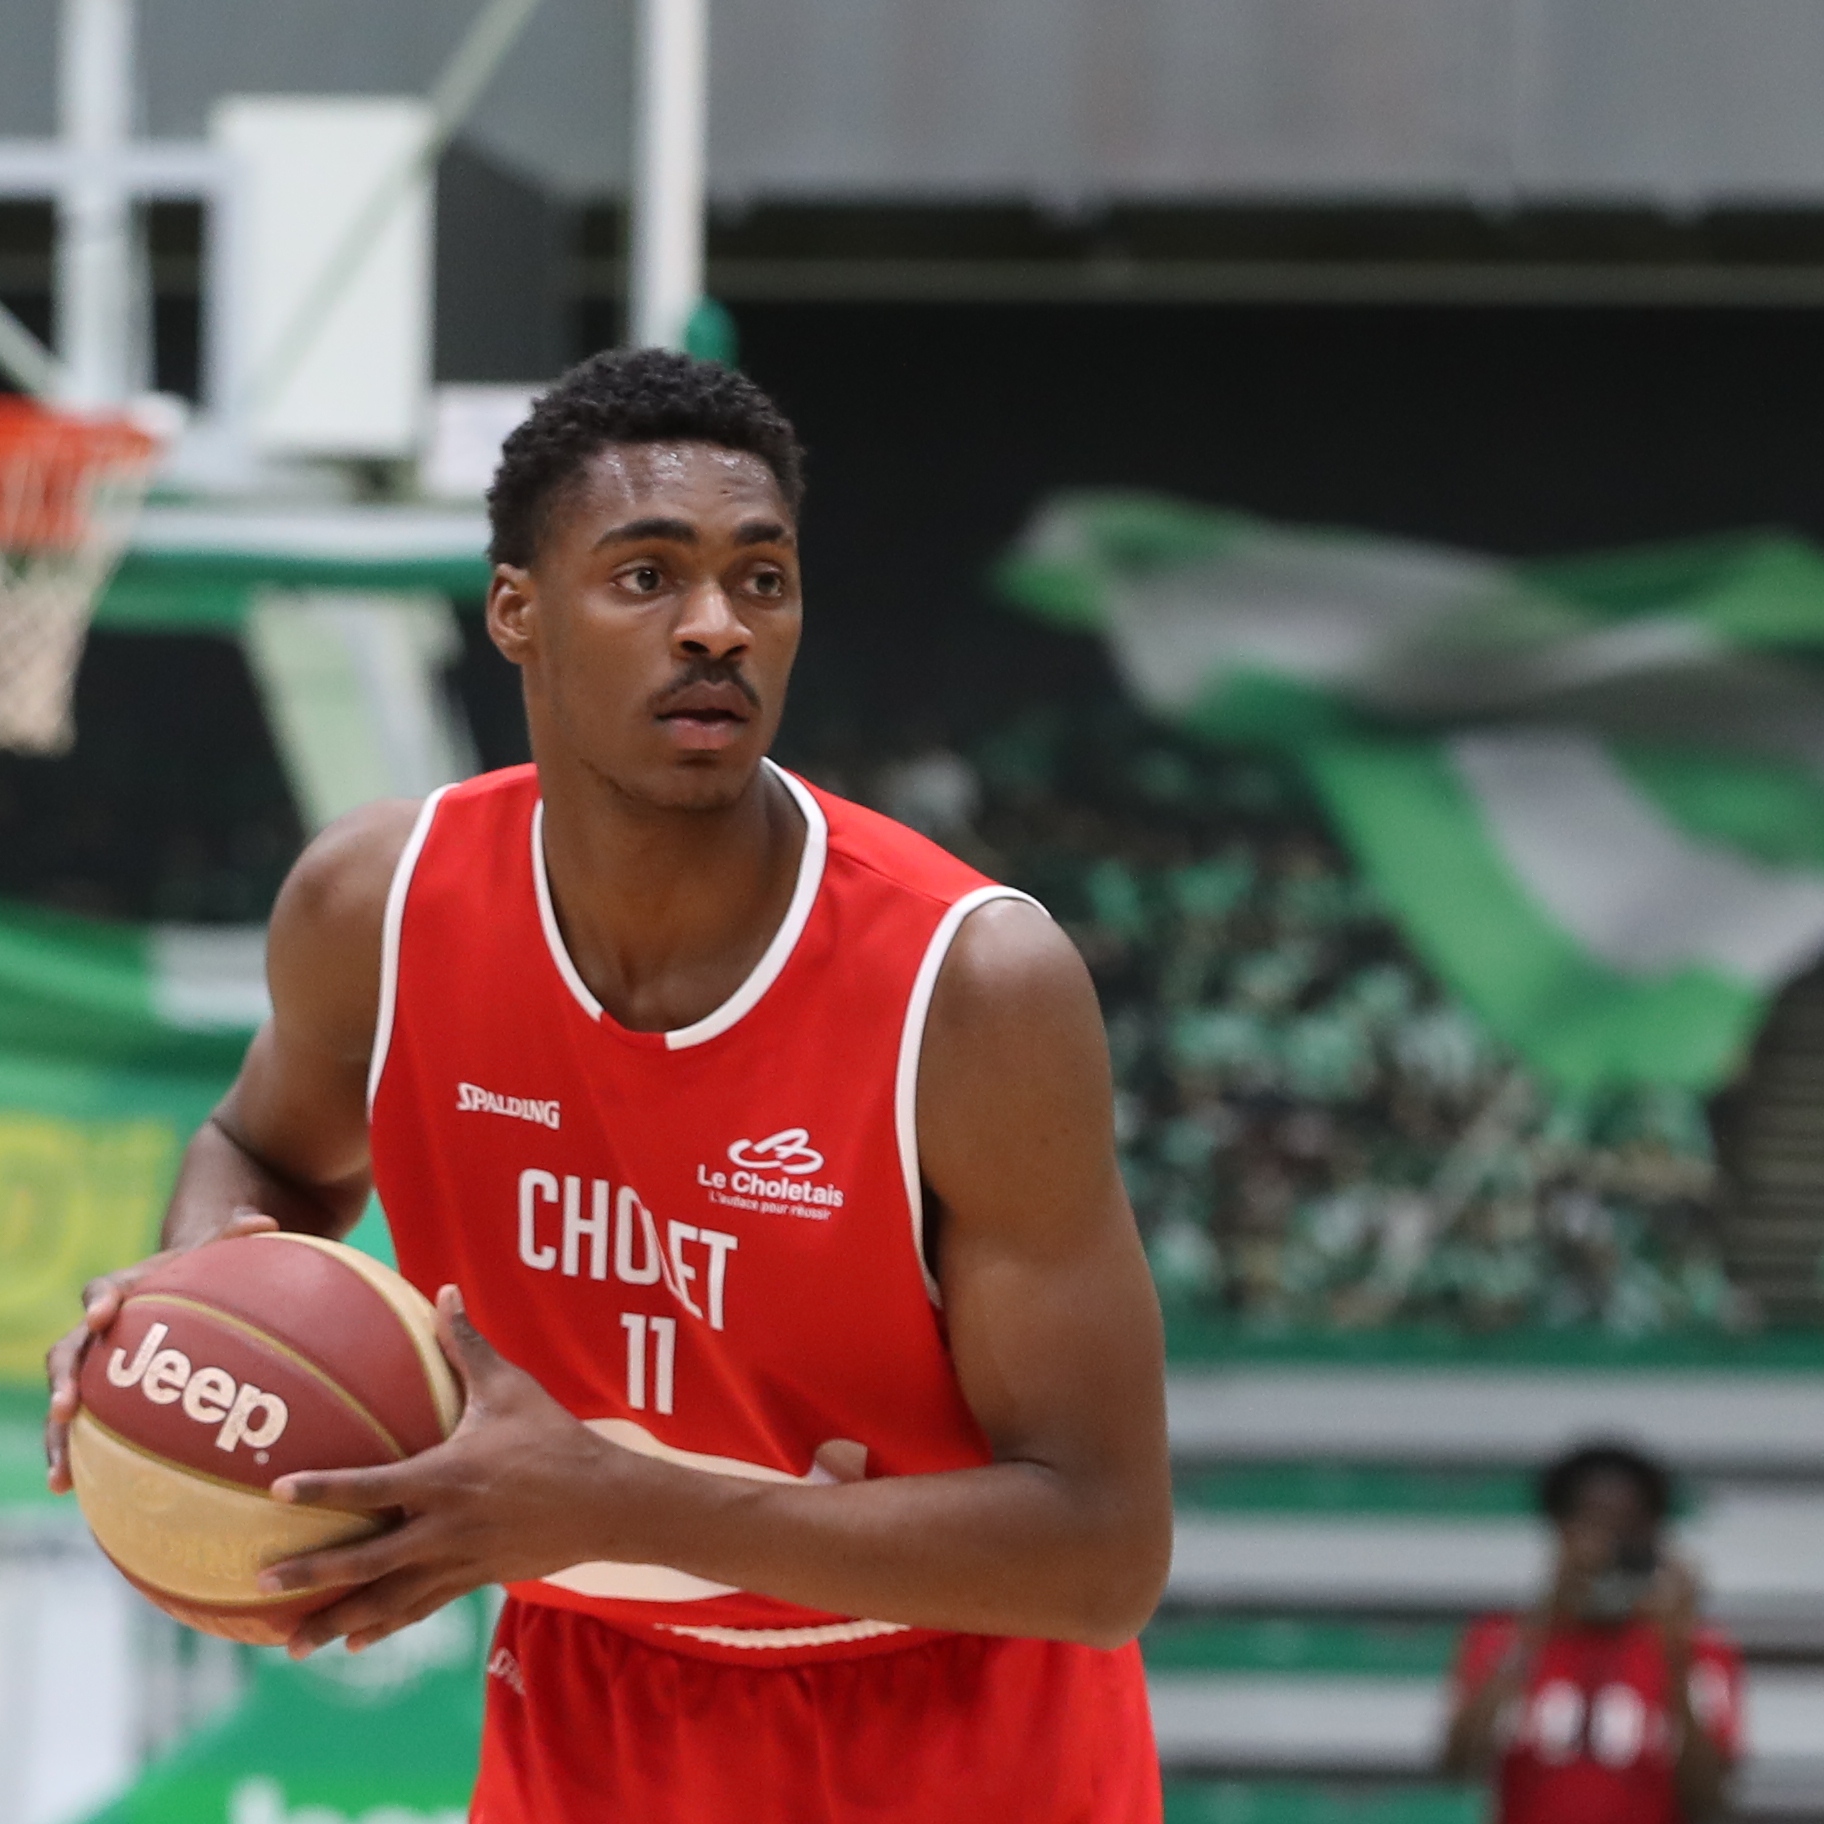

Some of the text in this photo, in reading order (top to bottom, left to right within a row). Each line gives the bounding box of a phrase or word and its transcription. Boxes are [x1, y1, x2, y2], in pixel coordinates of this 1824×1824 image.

[456, 1082, 560, 1130] SPALDING
[697, 1163, 845, 1208] Le Choletais
[106, 1322, 290, 1453] Jeep
[620, 1312, 676, 1415] 11
